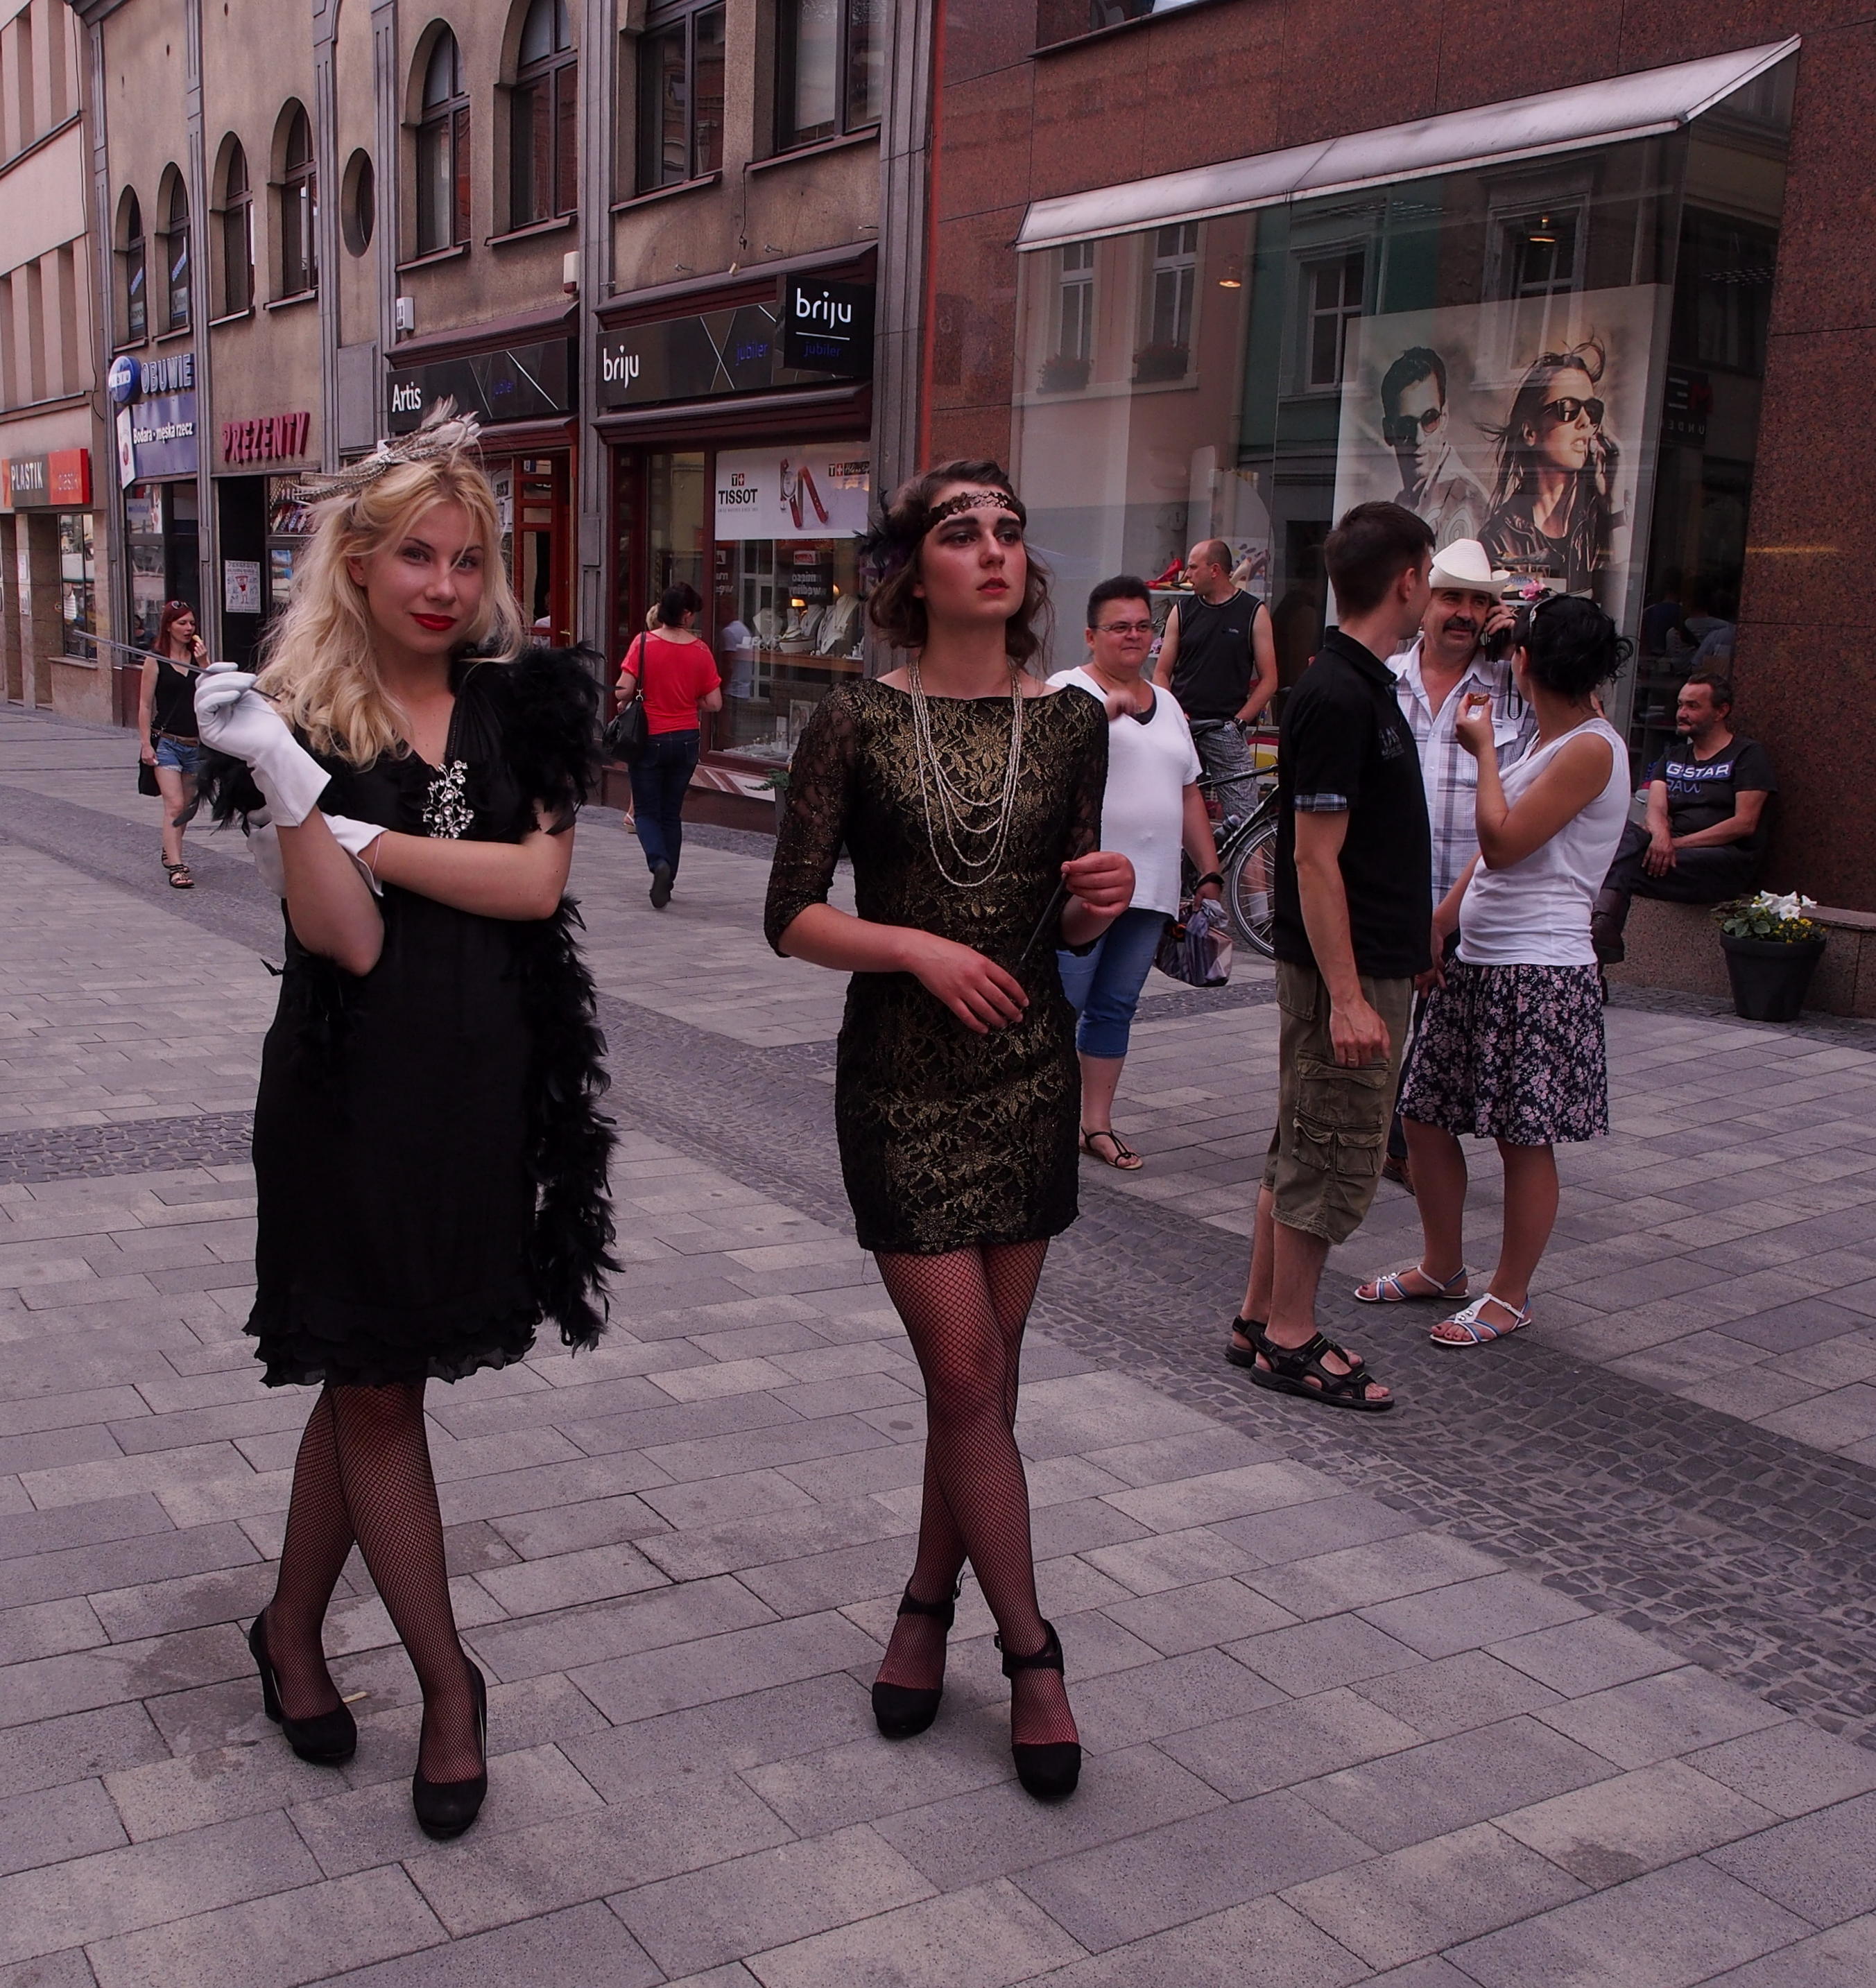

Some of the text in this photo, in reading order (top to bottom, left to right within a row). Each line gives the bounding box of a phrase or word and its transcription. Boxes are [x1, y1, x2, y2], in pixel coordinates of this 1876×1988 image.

[796, 287, 852, 328] briju
[735, 340, 768, 366] jubiler
[804, 340, 842, 358] jubiler
[141, 353, 193, 394] OBUWIE
[603, 345, 639, 388] briju
[392, 381, 422, 413] Artis
[133, 427, 153, 444] Bodara
[176, 422, 193, 438] rzecz
[223, 411, 309, 464] PREZENTY
[11, 462, 43, 491] PLASTIK
[718, 489, 758, 505] TISSOT
